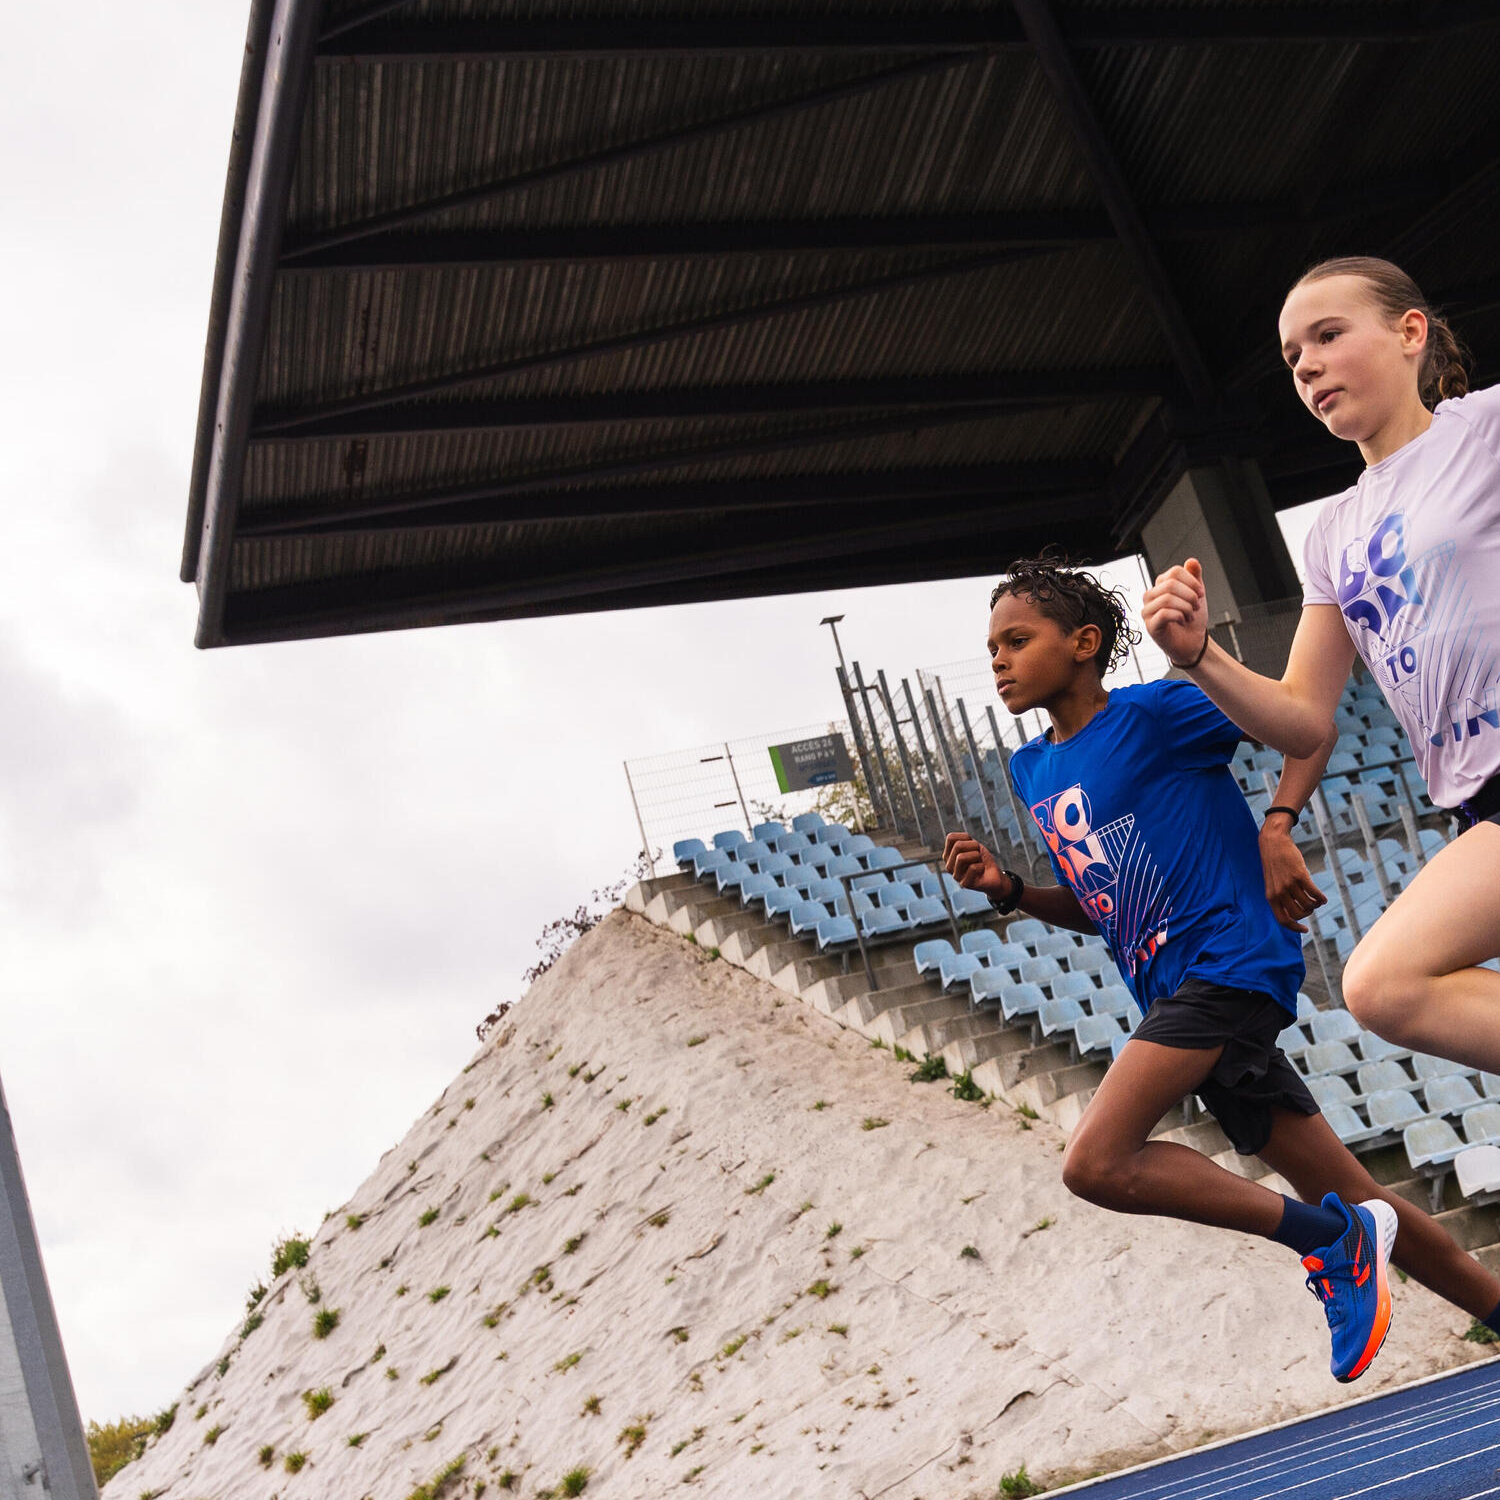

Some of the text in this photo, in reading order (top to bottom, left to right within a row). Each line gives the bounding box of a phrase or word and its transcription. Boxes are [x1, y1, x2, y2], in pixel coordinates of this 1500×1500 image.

[1386, 645, 1418, 684] TO
[822, 737, 834, 747] 26
[1087, 892, 1114, 920] TO
